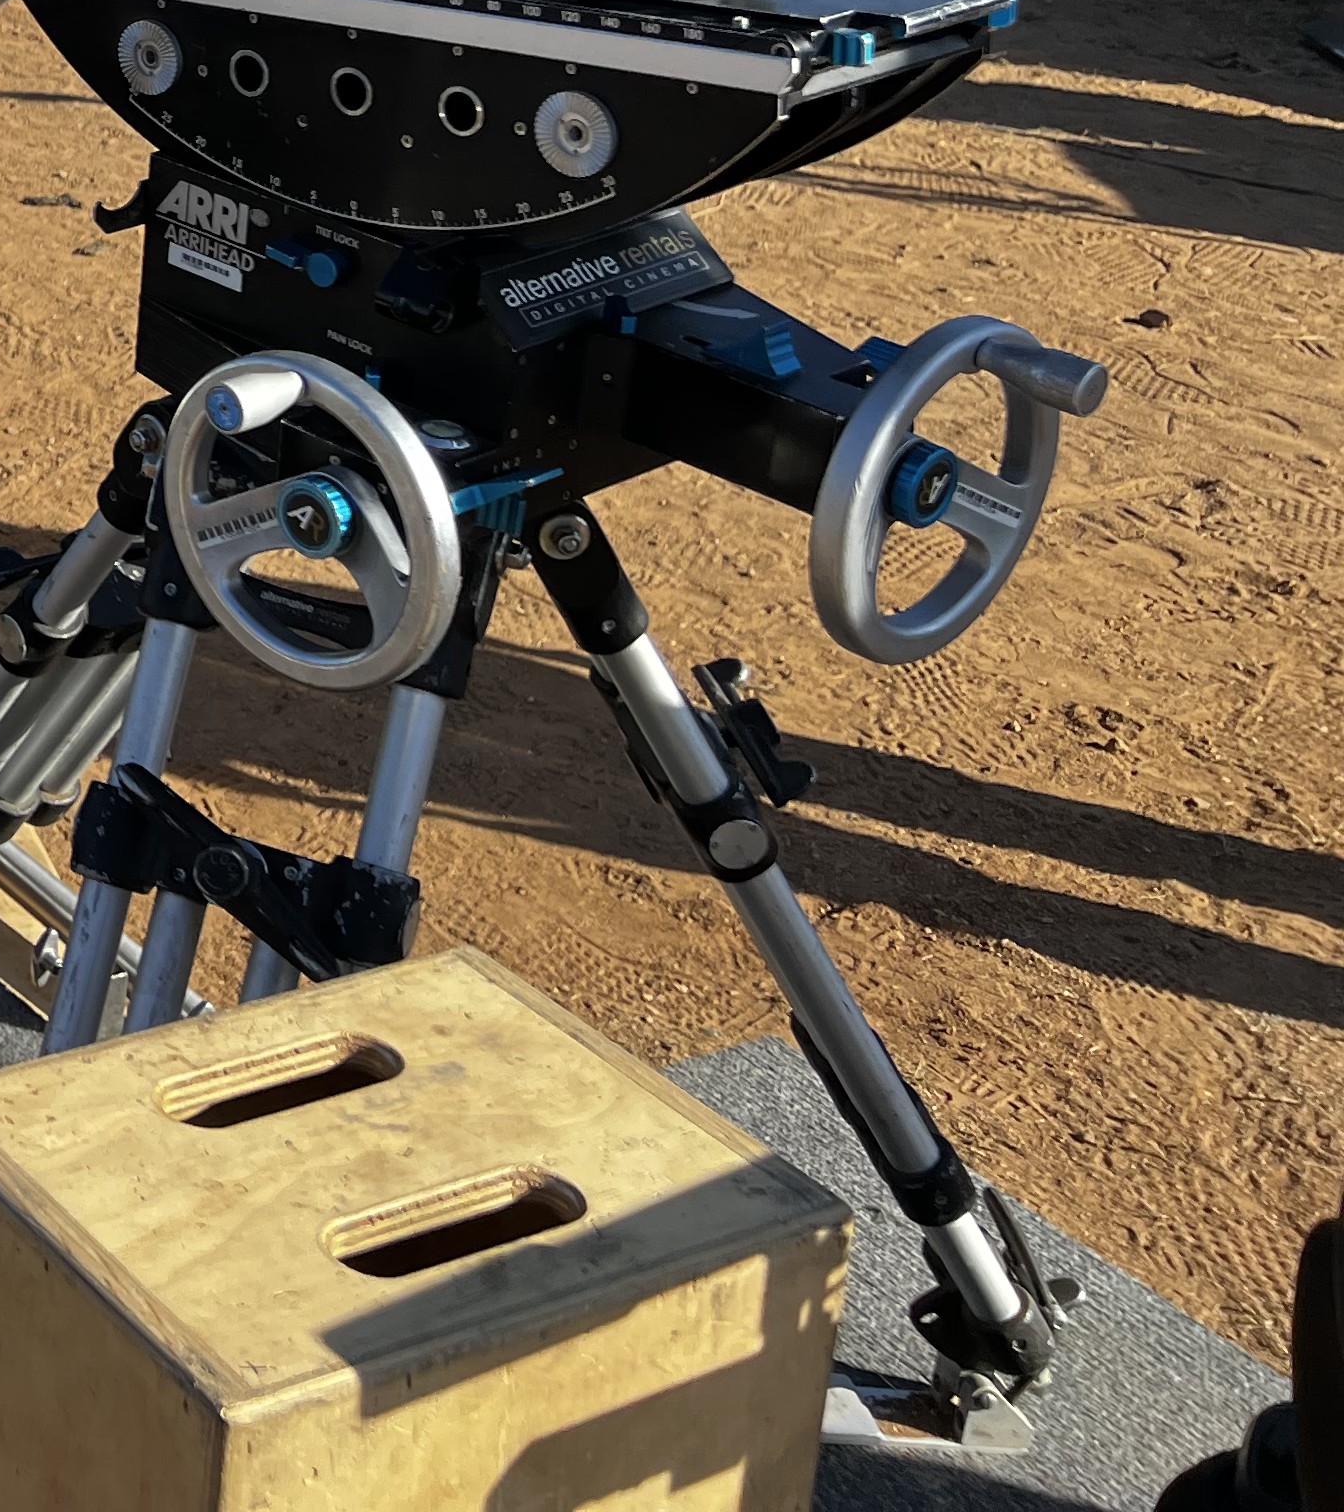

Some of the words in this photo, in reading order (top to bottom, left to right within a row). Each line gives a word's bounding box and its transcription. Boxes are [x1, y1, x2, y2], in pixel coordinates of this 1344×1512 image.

[522, 5, 541, 16] 100
[156, 180, 250, 245] ARRI
[270, 175, 281, 186] 10
[310, 190, 317, 200] 5
[430, 210, 445, 221] 10
[474, 208, 488, 218] 15
[164, 223, 256, 272] ARRIHEAD
[315, 225, 332, 239] TILT
[333, 232, 359, 249] LOCK
[500, 255, 621, 308] alternative
[618, 229, 697, 268] rentals
[529, 286, 615, 321] DIGITAL
[623, 258, 699, 289] CINEMA
[326, 329, 347, 345] PAN
[347, 338, 373, 355] LOCK
[286, 505, 326, 542] AR
